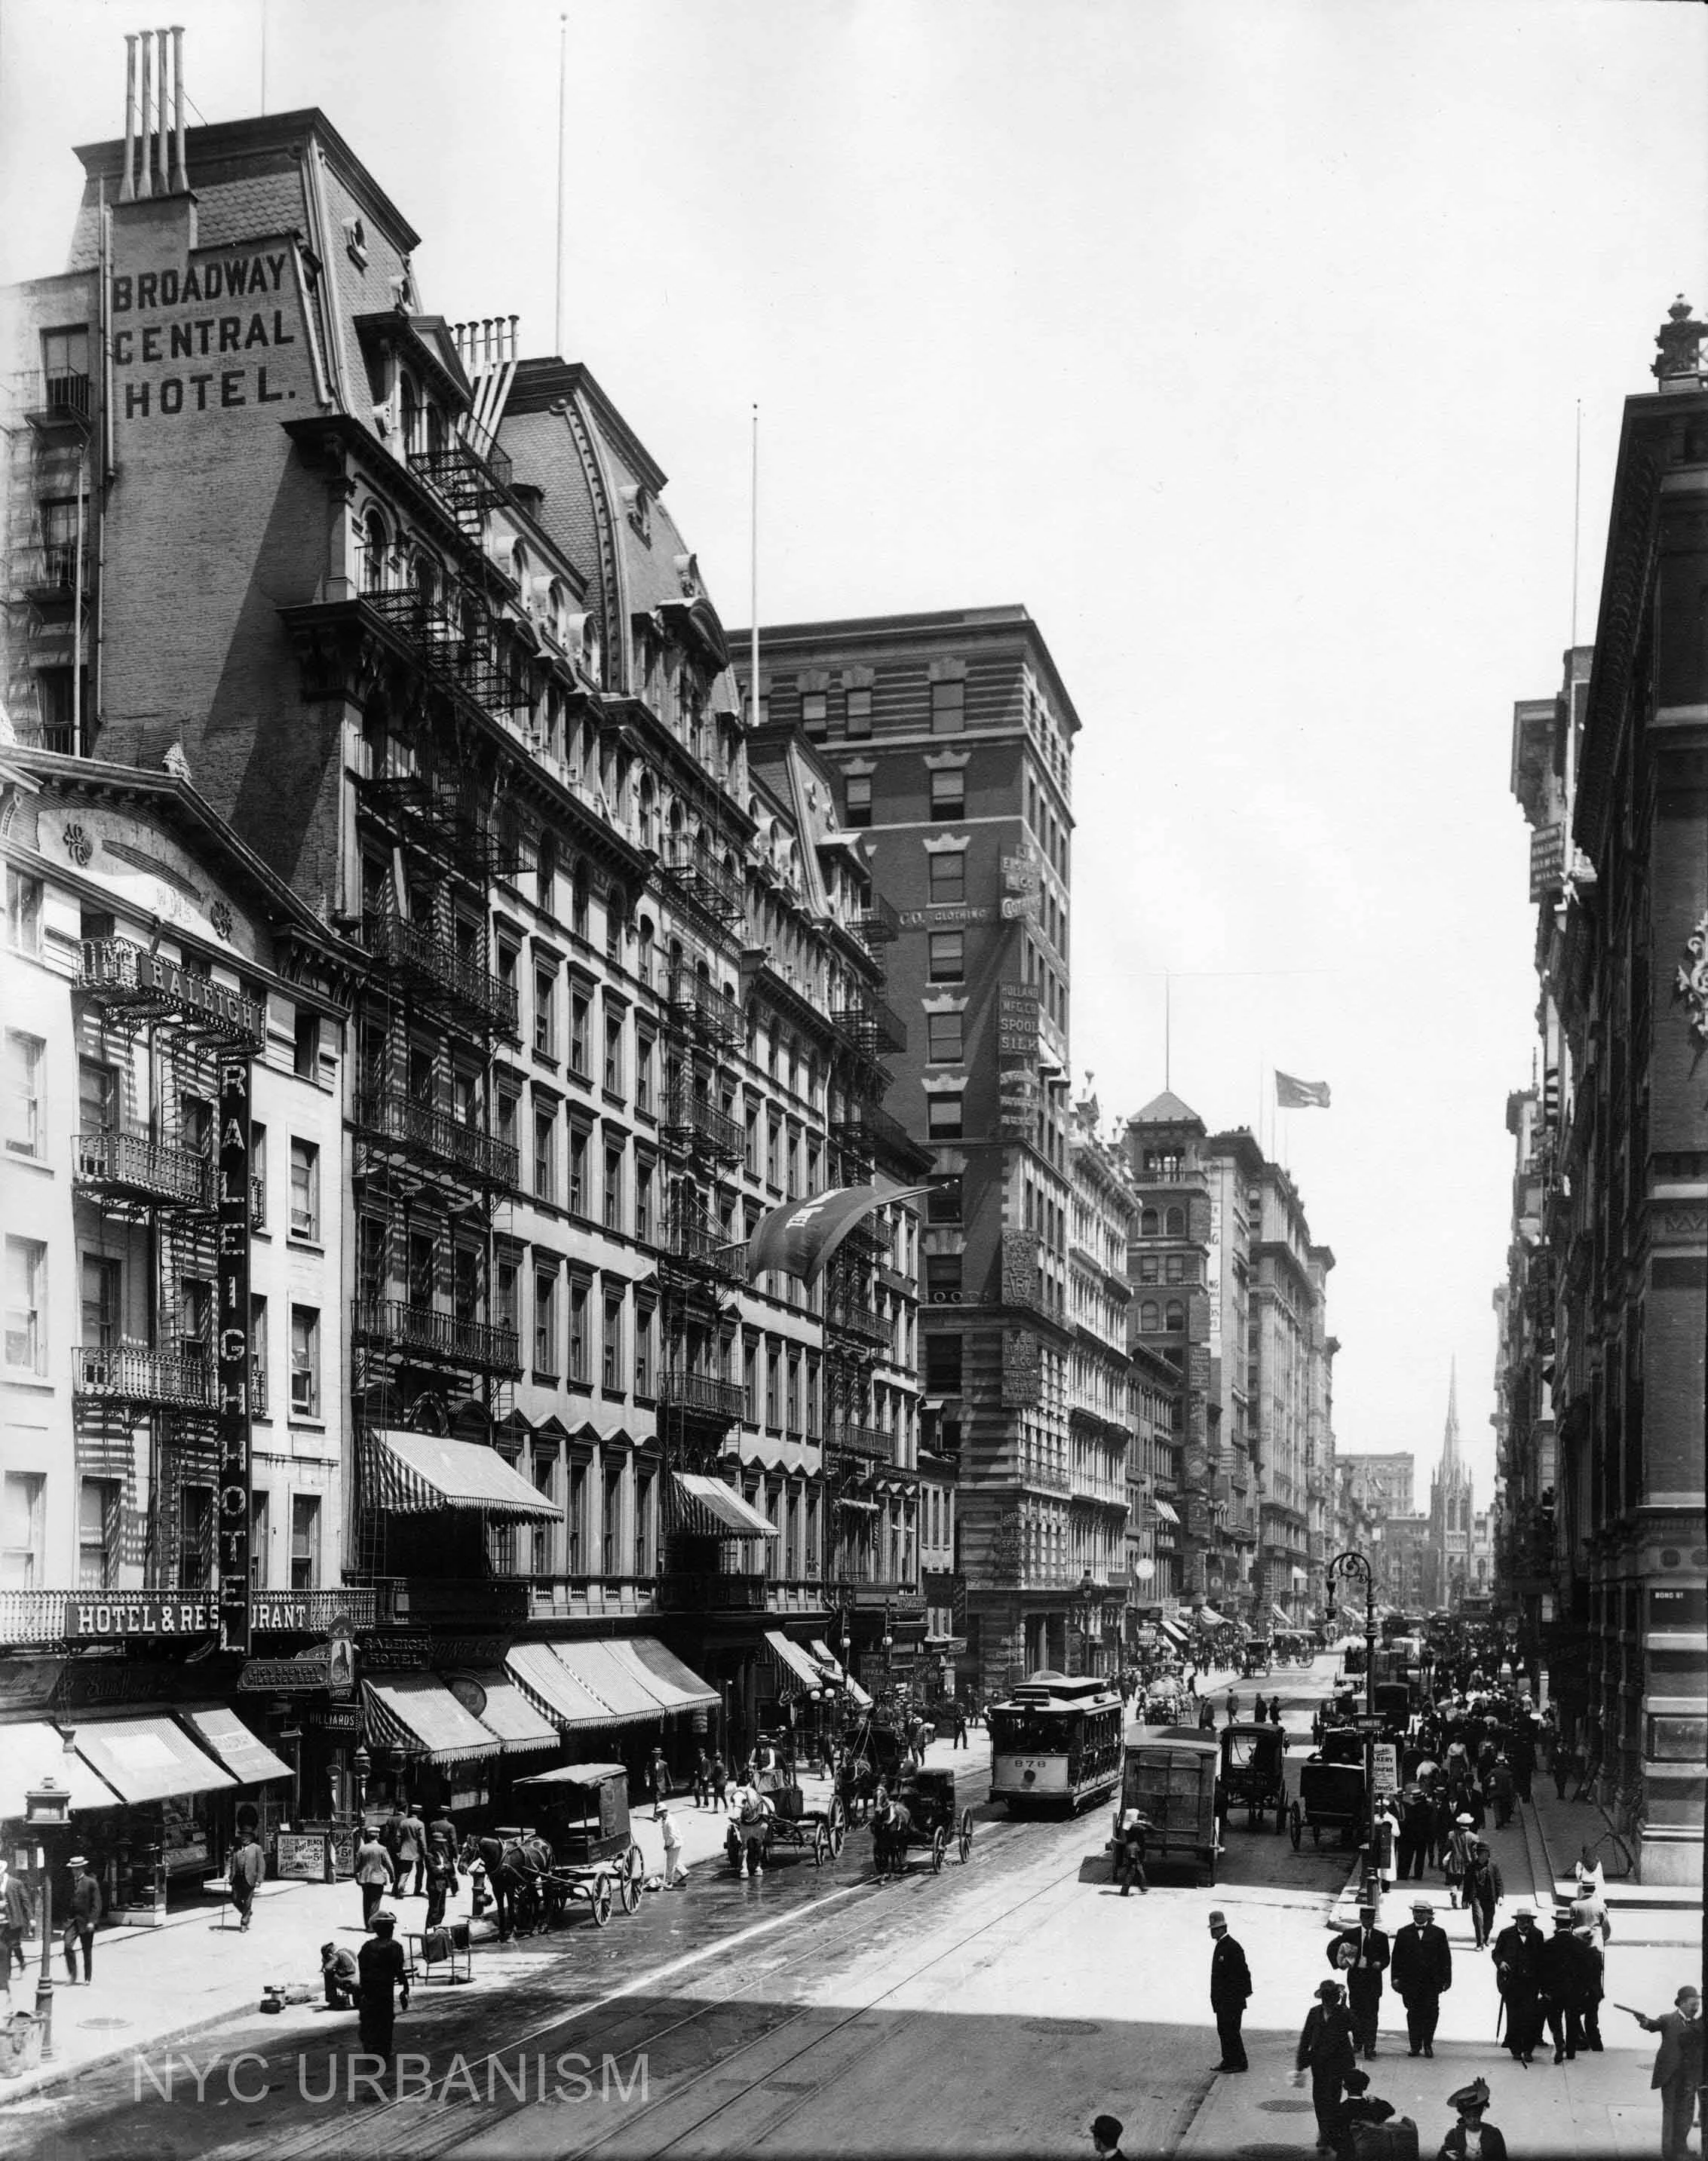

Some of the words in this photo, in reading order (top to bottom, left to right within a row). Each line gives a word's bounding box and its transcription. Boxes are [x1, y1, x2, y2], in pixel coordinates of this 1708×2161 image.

[111, 253, 287, 311] BROADWAY
[115, 308, 295, 365] CENTRAL
[124, 365, 296, 419] HOTEL.
[935, 908, 987, 921] CLOTHING
[150, 959, 254, 1031] RALEIGH
[1001, 1018, 1038, 1033] SPOOL
[1001, 1036, 1038, 1050] SILK
[219, 1064, 247, 1416] RALEIGH
[219, 1441, 247, 1653] HOTEL
[78, 1605, 157, 1633] HOTEL
[161, 1605, 175, 1632] &
[180, 1605, 306, 1632] RESURANT
[363, 1638, 429, 1651] RALEIGH
[368, 1653, 423, 1665] HOTEL
[276, 1665, 320, 1675] BREWERY
[308, 1712, 356, 1726] BILLIARDS
[1014, 1759, 1046, 1768] 878
[307, 1839, 324, 1847] BLACK
